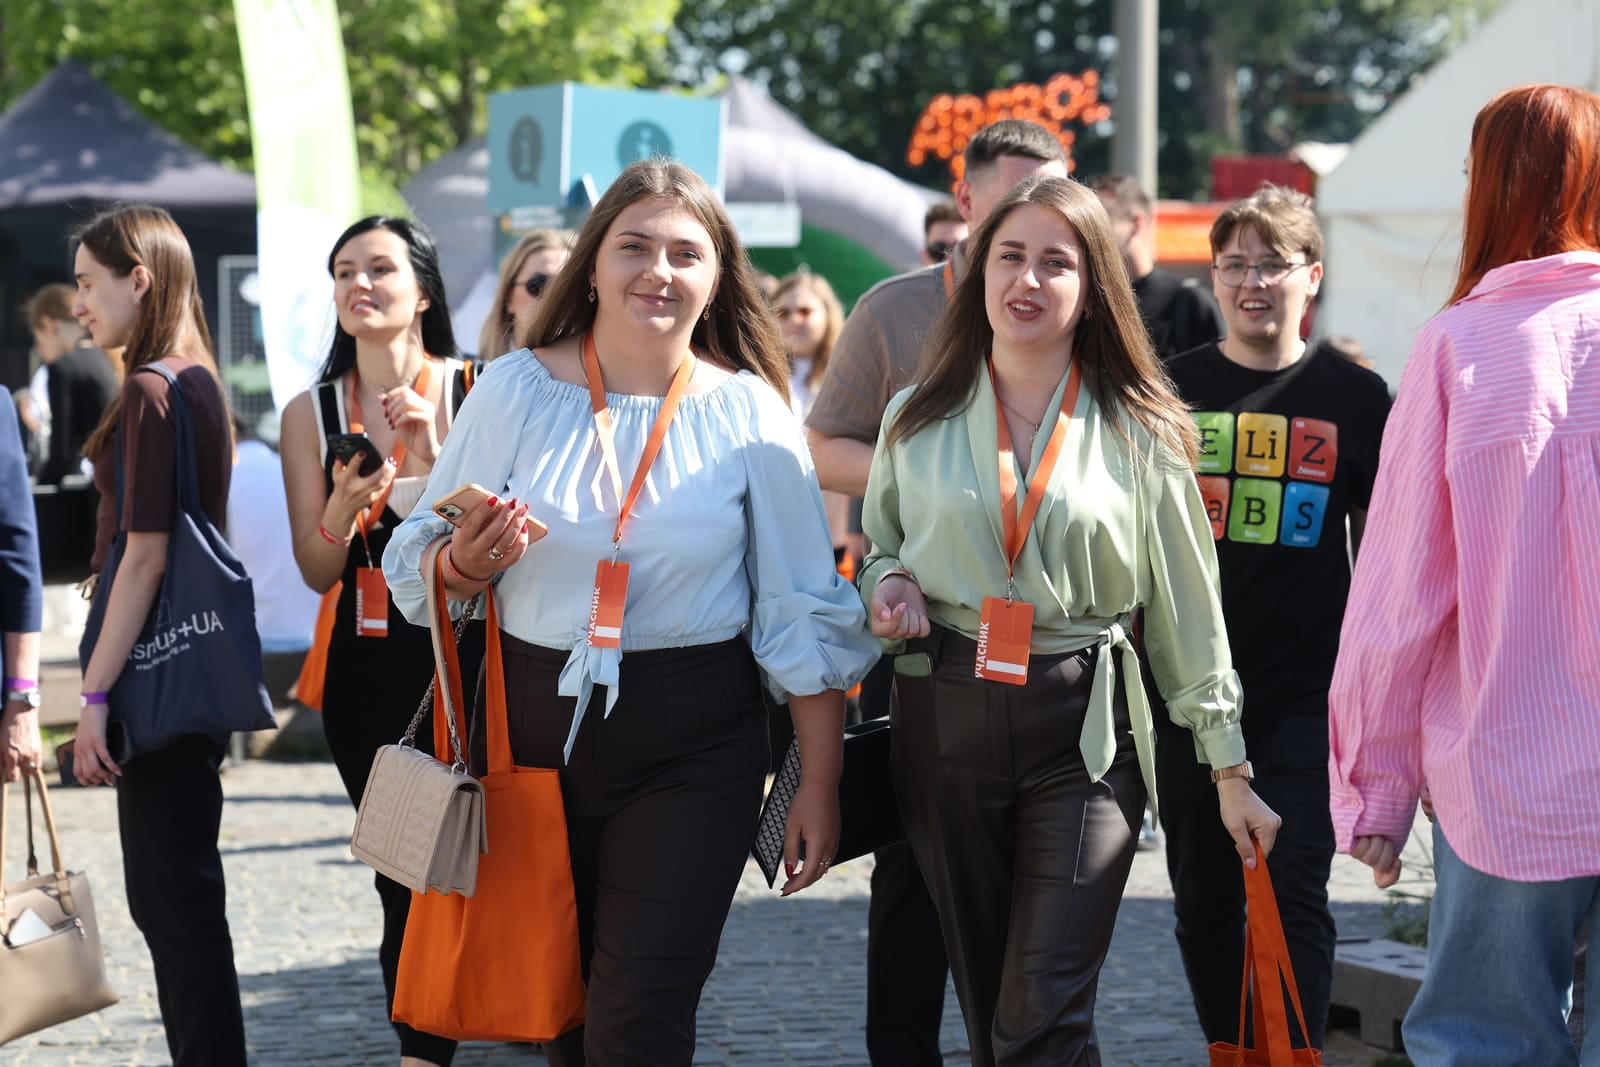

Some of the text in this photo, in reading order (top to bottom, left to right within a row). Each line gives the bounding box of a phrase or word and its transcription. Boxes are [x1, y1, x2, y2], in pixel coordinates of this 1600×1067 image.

[1208, 499, 1223, 523] a
[585, 586, 601, 647] УЧАСНИК
[974, 621, 990, 679] УЧАСНИК
